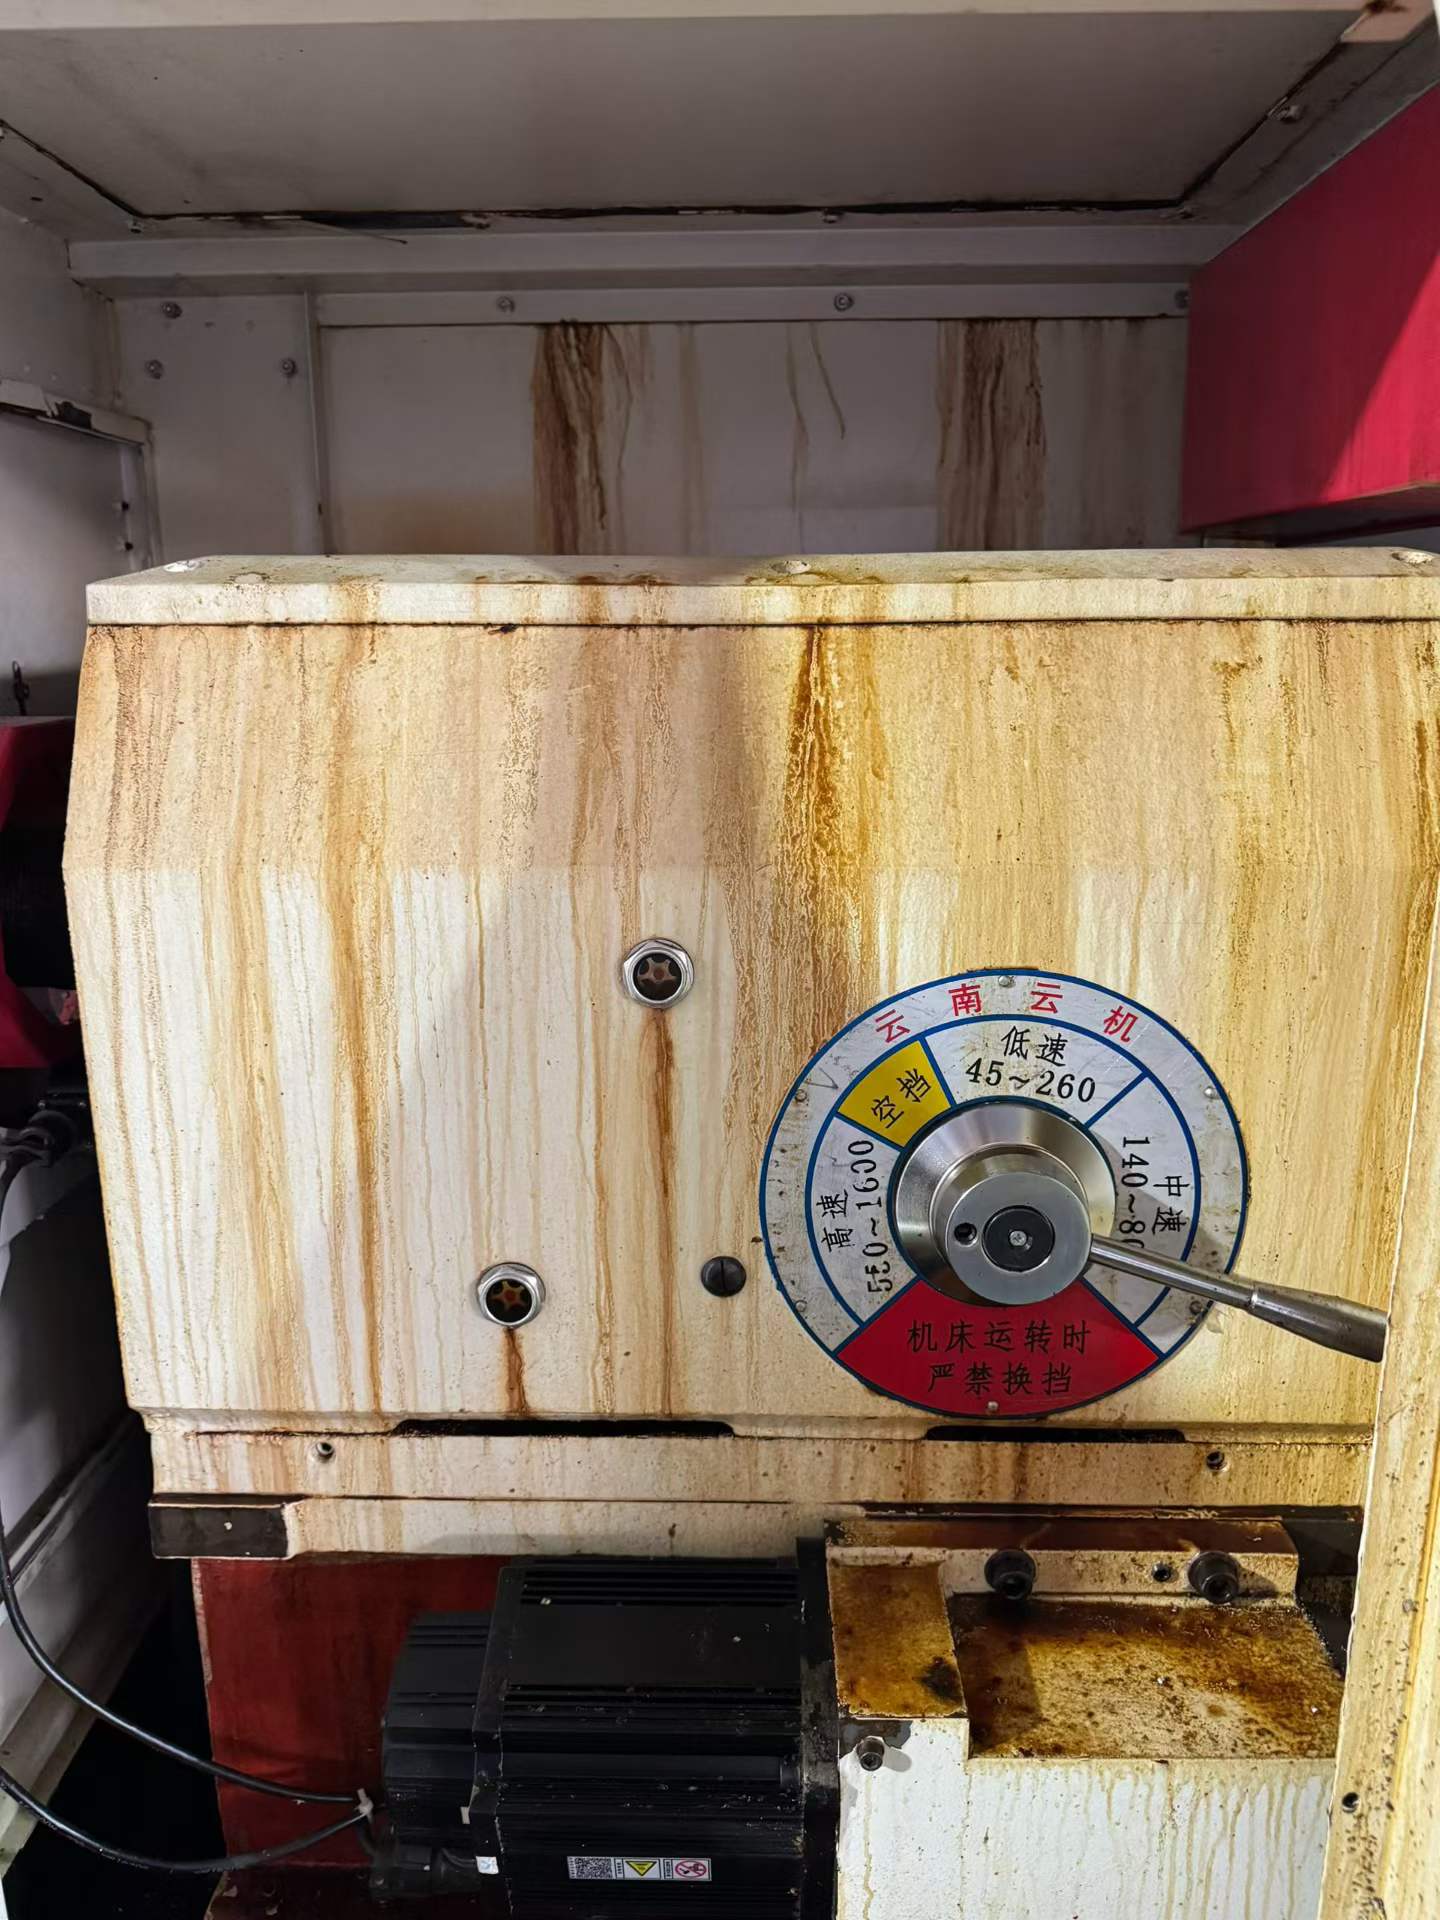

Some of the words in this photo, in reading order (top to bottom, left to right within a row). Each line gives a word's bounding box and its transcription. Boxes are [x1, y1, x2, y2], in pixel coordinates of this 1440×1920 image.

[874, 981, 1139, 1044] 云南云机
[1000, 1025, 1068, 1068] 低速
[871, 1067, 932, 1129] 空挡
[965, 1057, 1096, 1103] 45~260
[815, 1188, 854, 1253] 高速
[1151, 1175, 1190, 1236] 中速
[907, 1319, 1092, 1355] 机床运转时
[927, 1361, 1073, 1396] 严禁换挡
